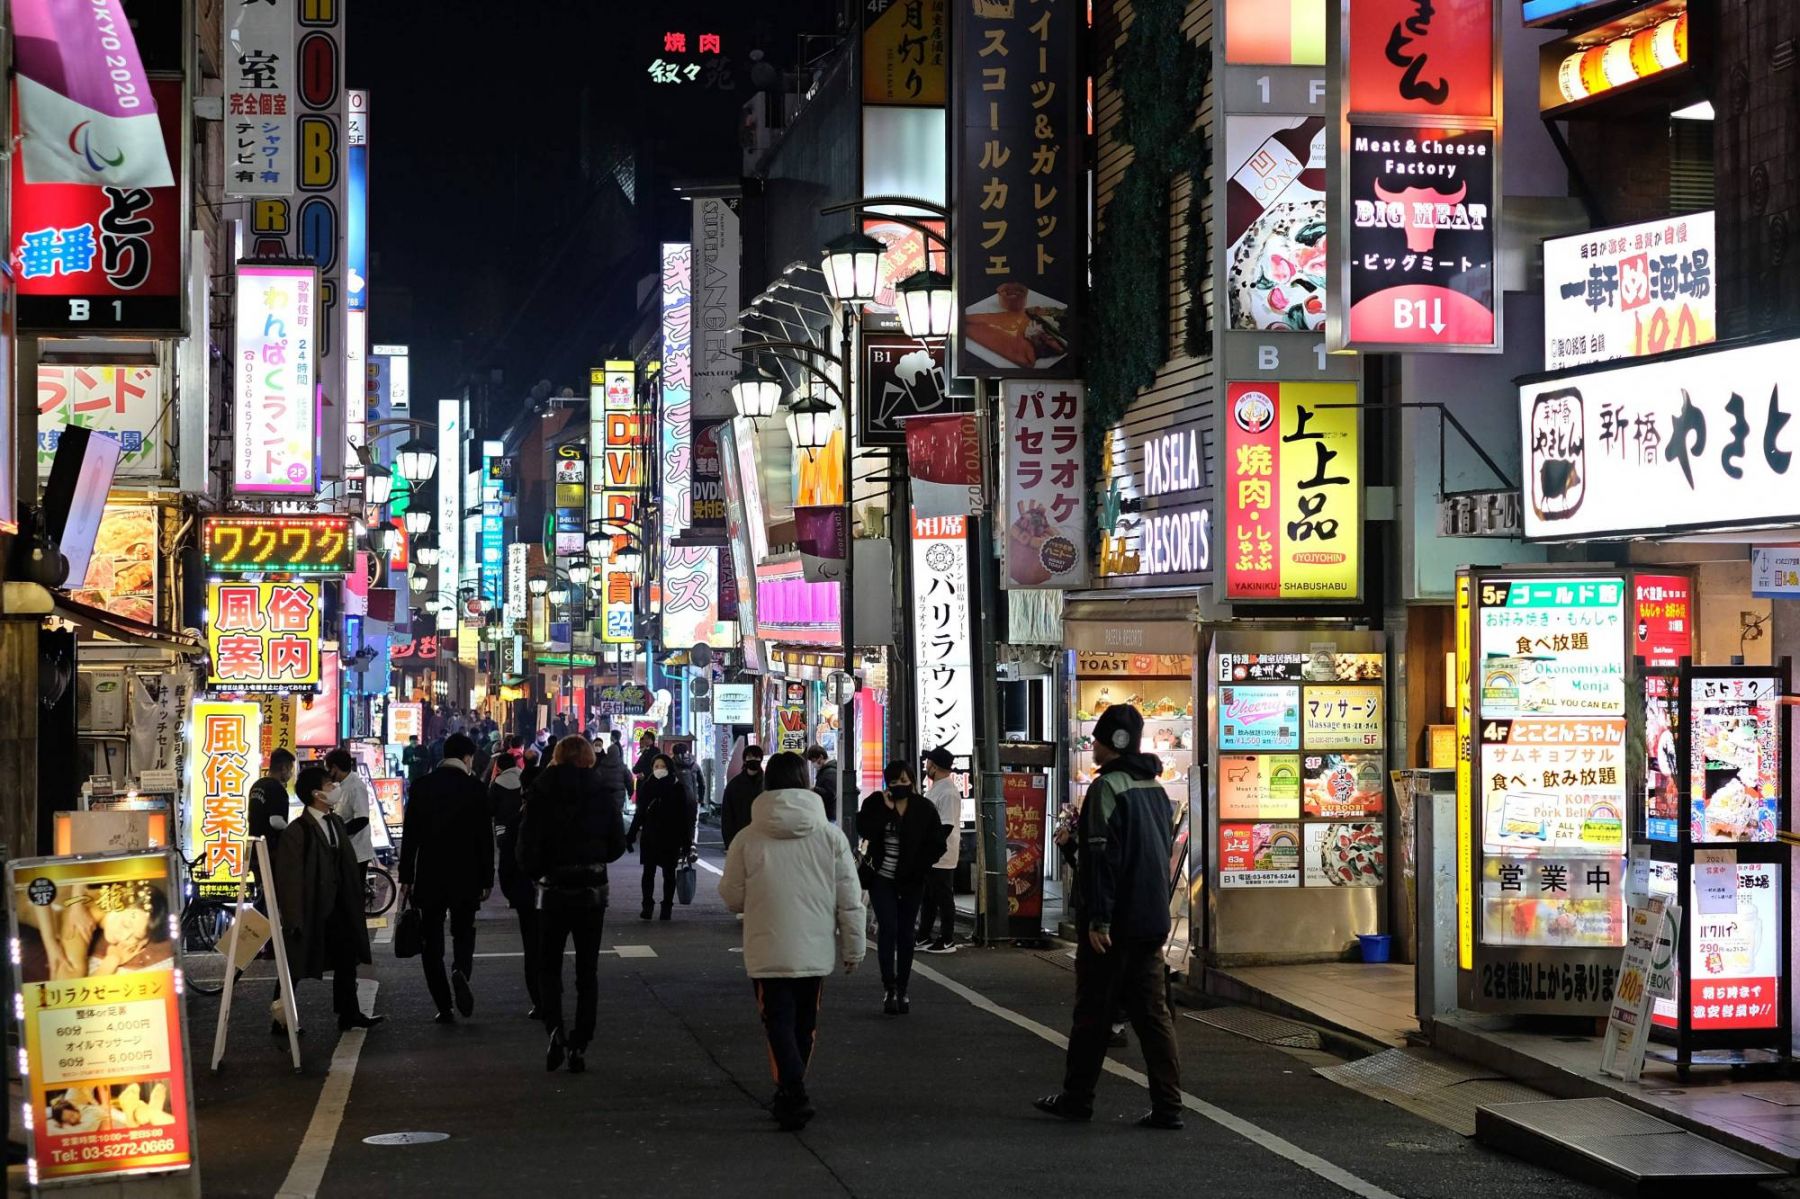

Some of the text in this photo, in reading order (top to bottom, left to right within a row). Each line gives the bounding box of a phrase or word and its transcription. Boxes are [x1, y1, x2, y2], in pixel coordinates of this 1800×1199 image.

[664, 32, 720, 54] 焼肉
[105, 55, 140, 108] 2020
[230, 93, 287, 116] 完全個室
[1029, 0, 1060, 275] イーツ&ガレット
[1356, 138, 1487, 156] Meat & Cheese
[235, 123, 254, 183] テレビ有
[260, 122, 280, 183] シャワー有
[978, 30, 1010, 275] スコールカフェ
[1254, 156, 1298, 202] CONA
[1386, 159, 1457, 179] Factory
[1355, 200, 1487, 231] BIG MEAT
[1561, 248, 1711, 312] 一軒め酒場
[1393, 298, 1428, 330] B1
[873, 351, 891, 363] B1
[262, 286, 289, 474] わんぱくランド
[1015, 391, 1044, 489] パセラ
[1534, 422, 1584, 458] やきとん
[1599, 403, 1661, 466] 新橋
[1665, 383, 1793, 490] やきと
[1050, 391, 1080, 523] カラオケ
[1143, 429, 1200, 496] PASELA
[1283, 405, 1350, 541] 上上品
[967, 472, 985, 518] 2020
[693, 500, 724, 519] 受付B
[916, 515, 963, 536] 相席
[214, 526, 345, 563] ワクワク
[1144, 509, 1209, 575] RESORTS
[1293, 552, 1343, 564] JYOJYOHIN
[1235, 582, 1348, 591] YAKINIKU SHABUSHABU
[1482, 585, 1507, 605] 5F
[216, 586, 314, 631] 風俗
[1516, 633, 1590, 655] 食べ放題
[217, 634, 312, 681] 案内
[925, 573, 961, 749] バリラウンジ
[1080, 659, 1128, 671] TOAST
[1535, 663, 1622, 677] Okonomiyaki
[1571, 680, 1610, 693] Monja
[1308, 699, 1378, 718] マッサージ
[1541, 698, 1620, 709] ALL YOU CAN EAT
[155, 685, 169, 770] キャッチセール
[1308, 720, 1340, 730] Massage
[1484, 723, 1623, 744] 4F とことんちゃん
[1363, 735, 1377, 745] 5F
[1305, 757, 1321, 769] 3F
[1491, 767, 1617, 792] 食べ・飲み放題
[202, 714, 251, 877] 風俗案内
[1534, 807, 1561, 818] Pork
[1555, 831, 1574, 839] EAT
[1224, 876, 1236, 884] B1
[1498, 864, 1610, 893] 営業中
[1738, 874, 1770, 889] 酒場
[33, 893, 51, 905] 3F
[51, 983, 162, 1004] リラクゼーション
[1483, 964, 1620, 1003] 2名様以上から承りま
[56, 1019, 151, 1037] 60分 4,000円
[66, 1036, 142, 1051] オイルマッサージ
[58, 1050, 153, 1068] 60分 6,000円
[51, 1148, 78, 1163] Tel:
